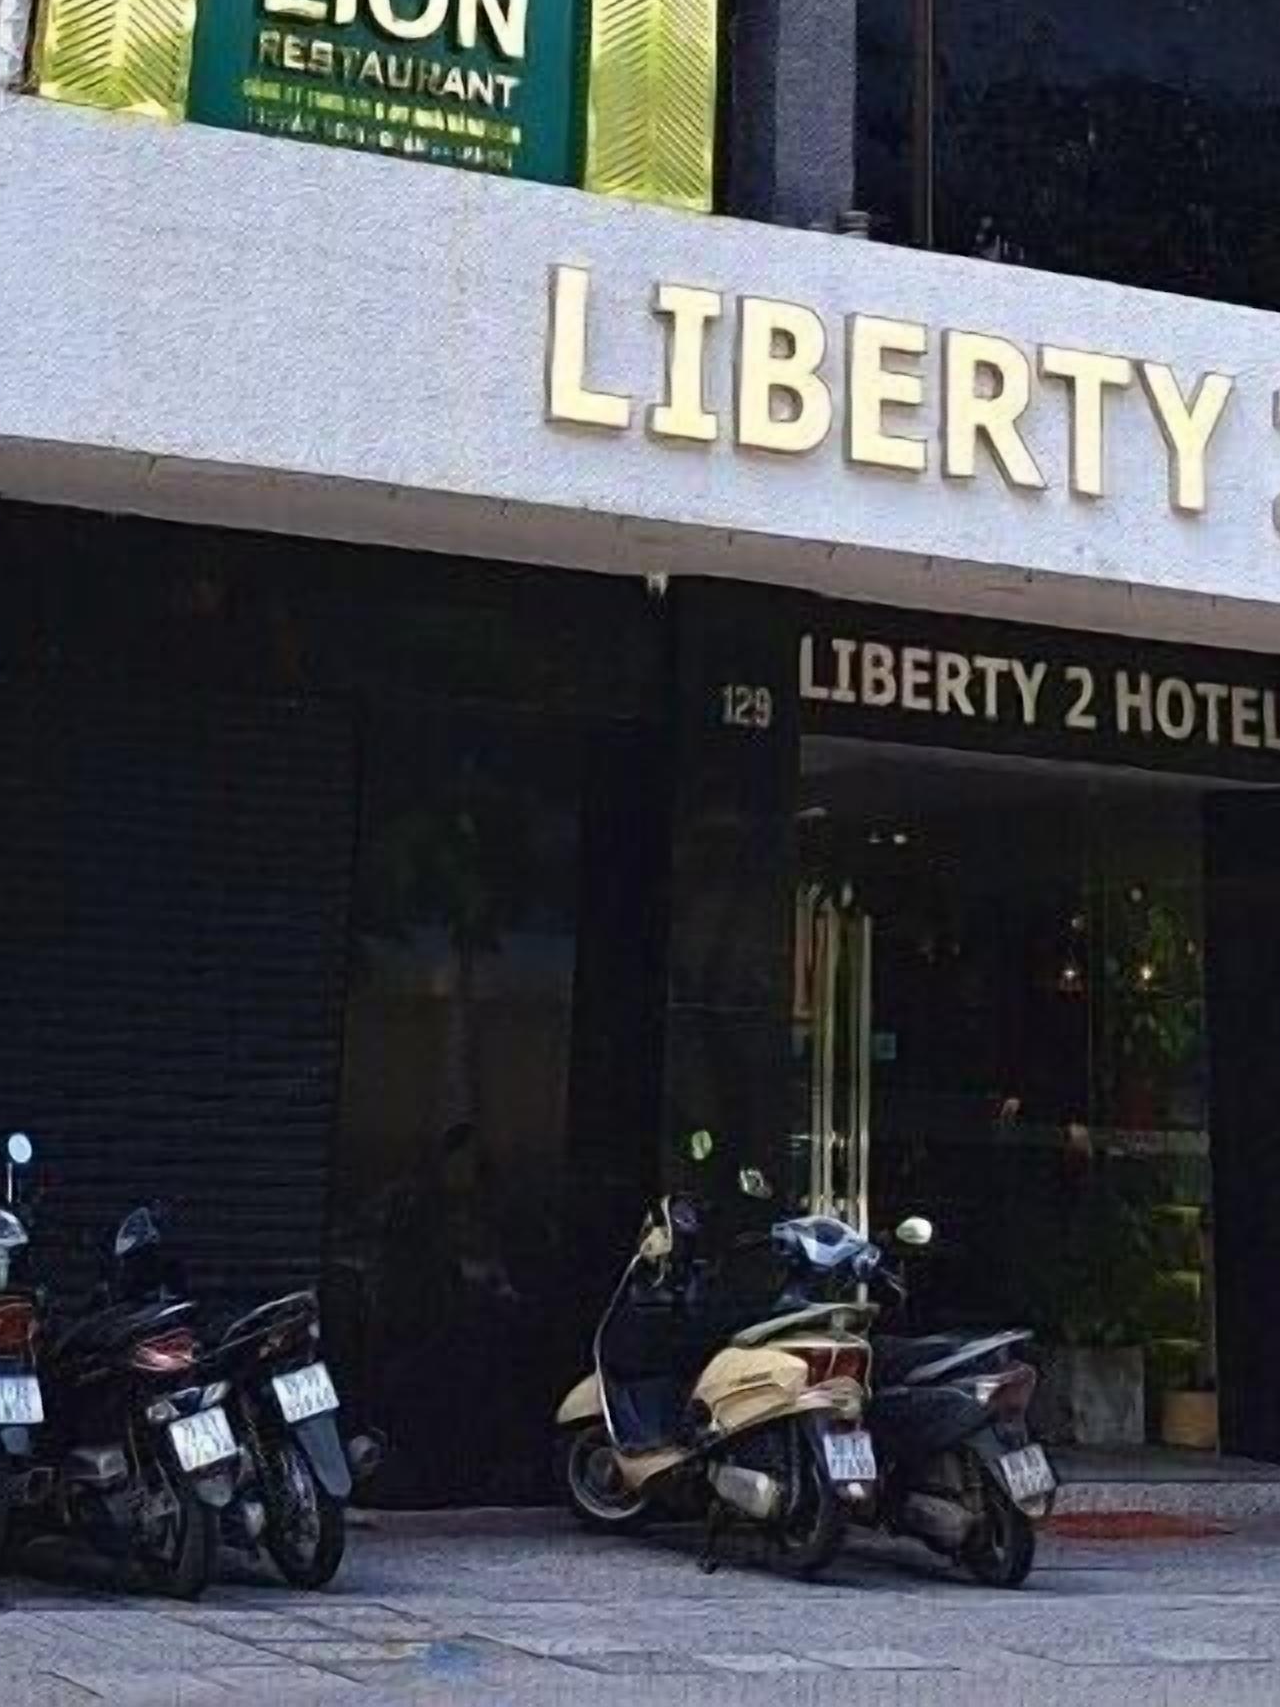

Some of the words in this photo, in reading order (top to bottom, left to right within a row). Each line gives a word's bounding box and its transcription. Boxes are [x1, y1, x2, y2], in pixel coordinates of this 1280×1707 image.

[259, 29, 520, 109] RESTAURANT
[546, 263, 1233, 513] LIBERTY
[723, 684, 772, 729] 129
[800, 635, 1046, 724] LIBERTY
[1064, 668, 1096, 729] 2
